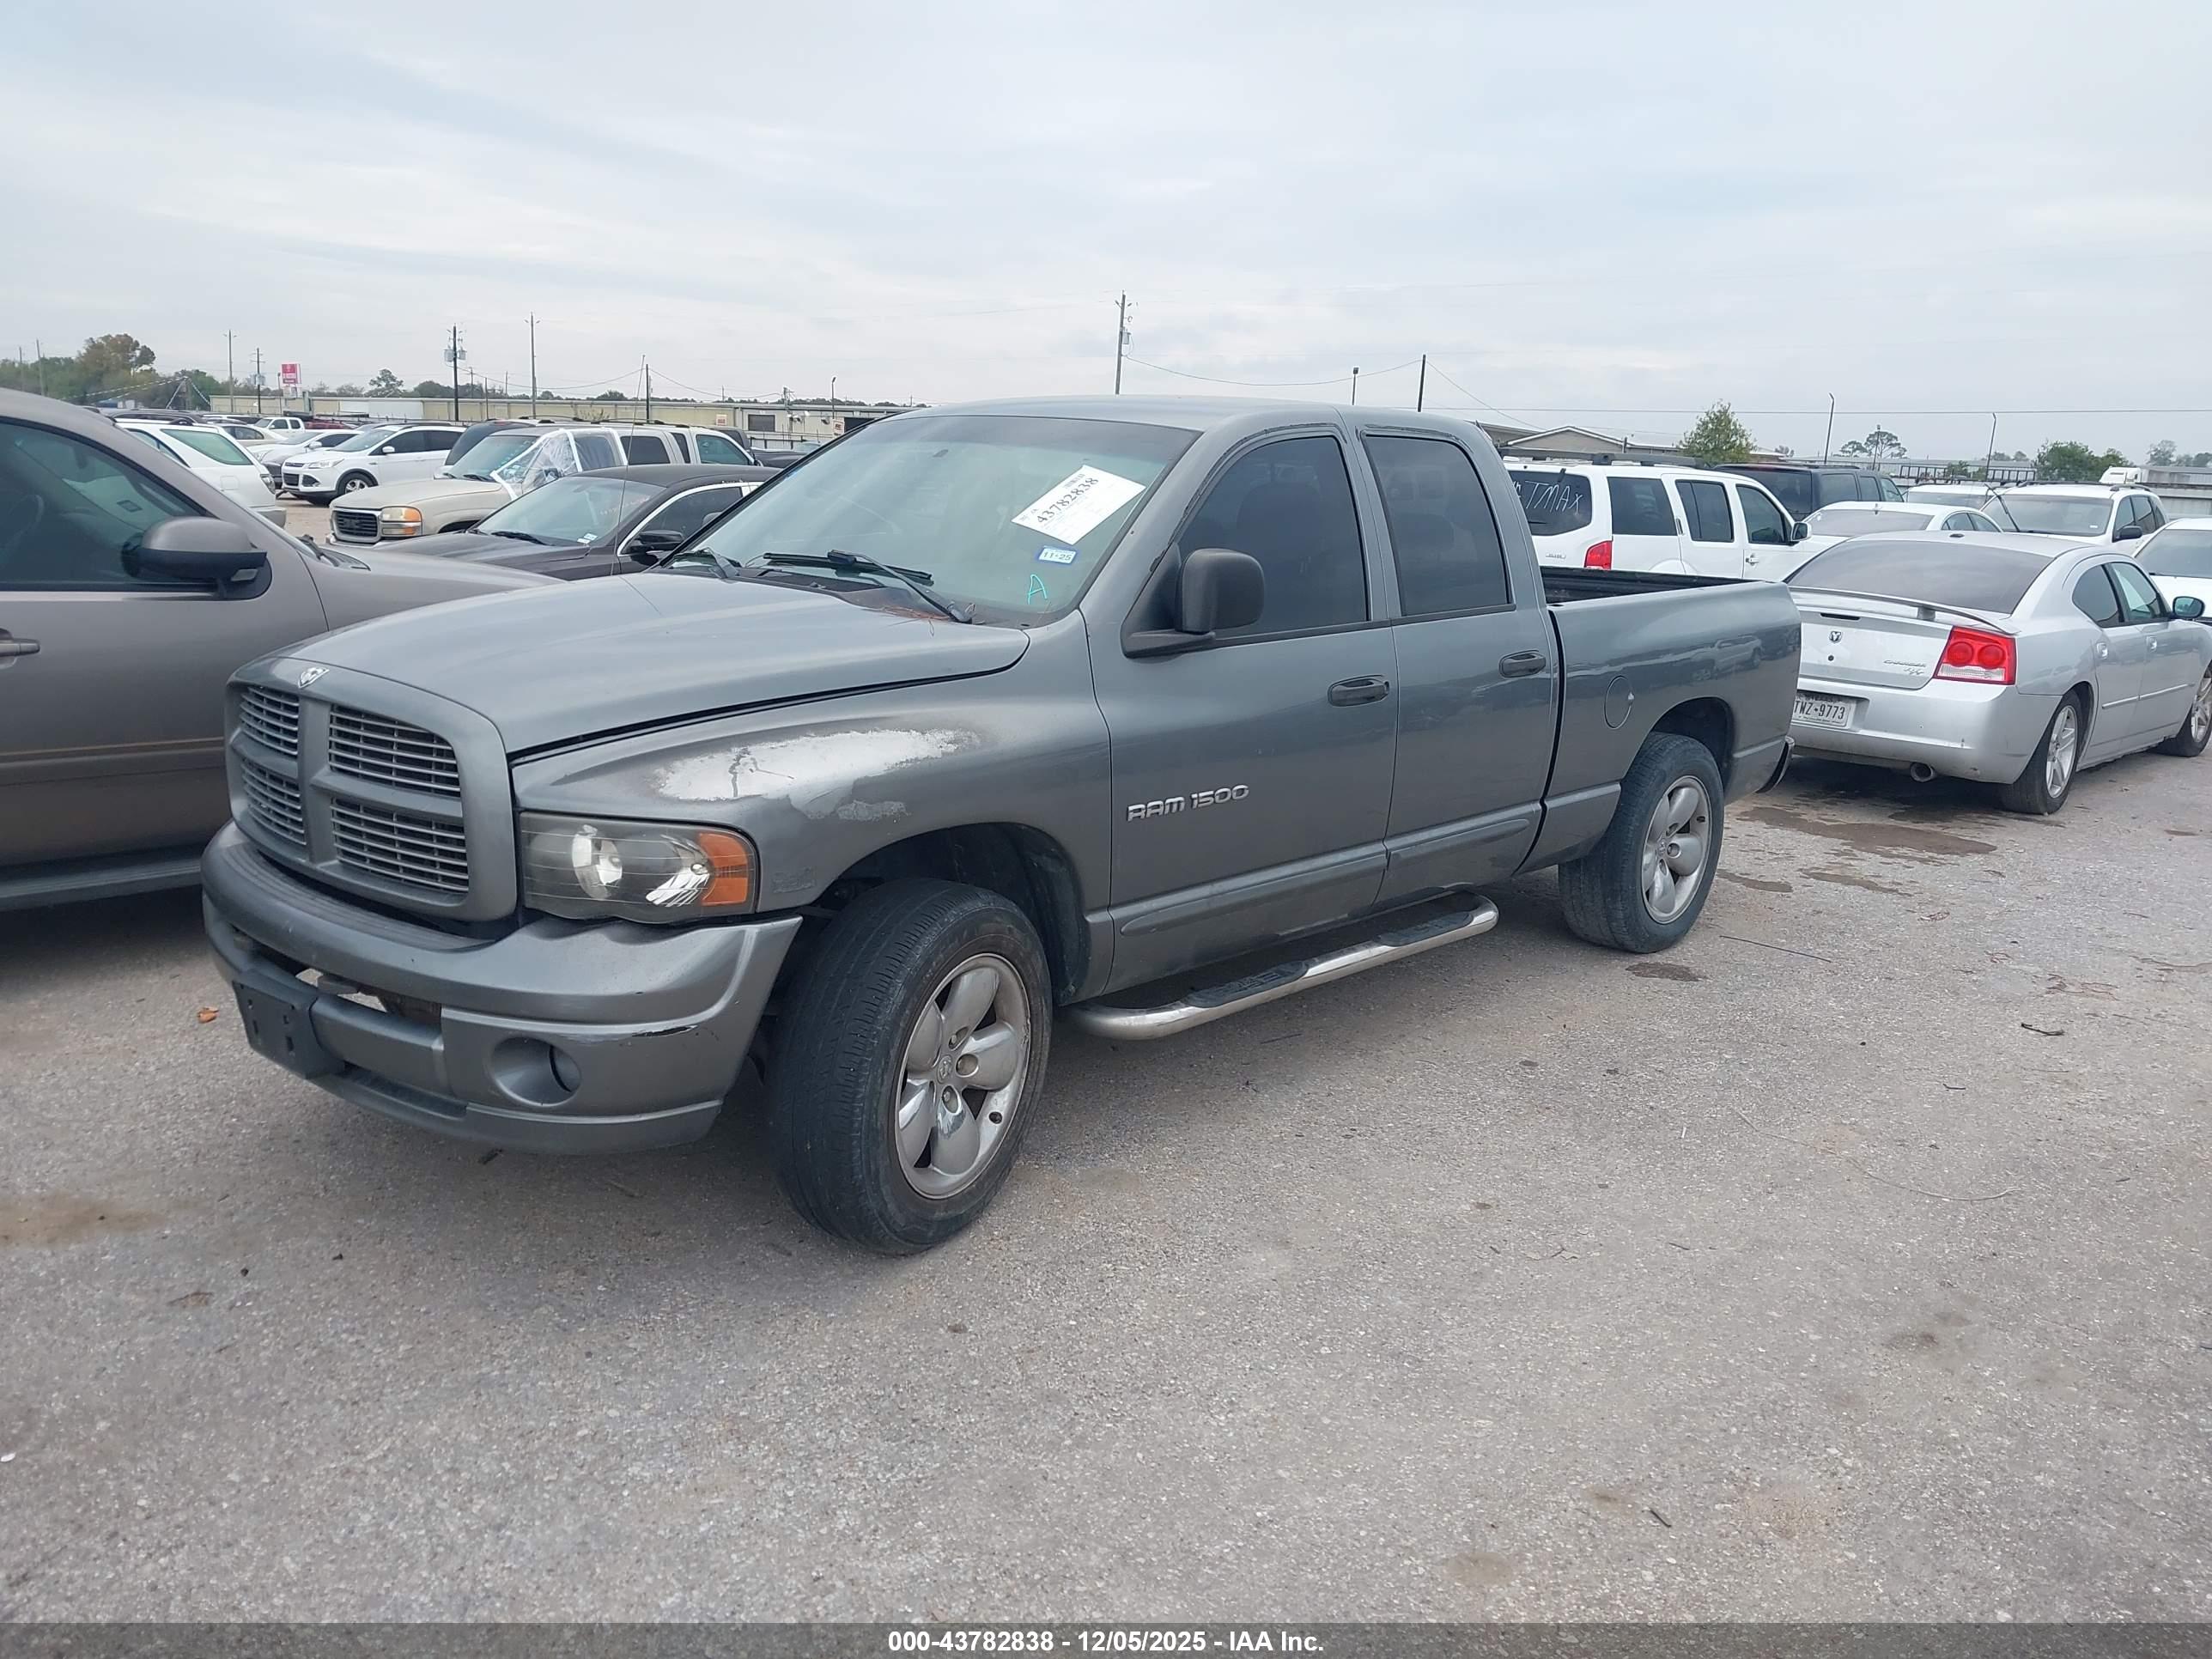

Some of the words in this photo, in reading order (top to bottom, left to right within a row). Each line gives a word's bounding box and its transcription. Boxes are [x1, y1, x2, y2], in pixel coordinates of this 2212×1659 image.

[1036, 477, 1099, 523] 43782838
[1027, 574, 1048, 605] A
[1127, 796, 1186, 822] RAM
[1191, 784, 1249, 809] 1500
